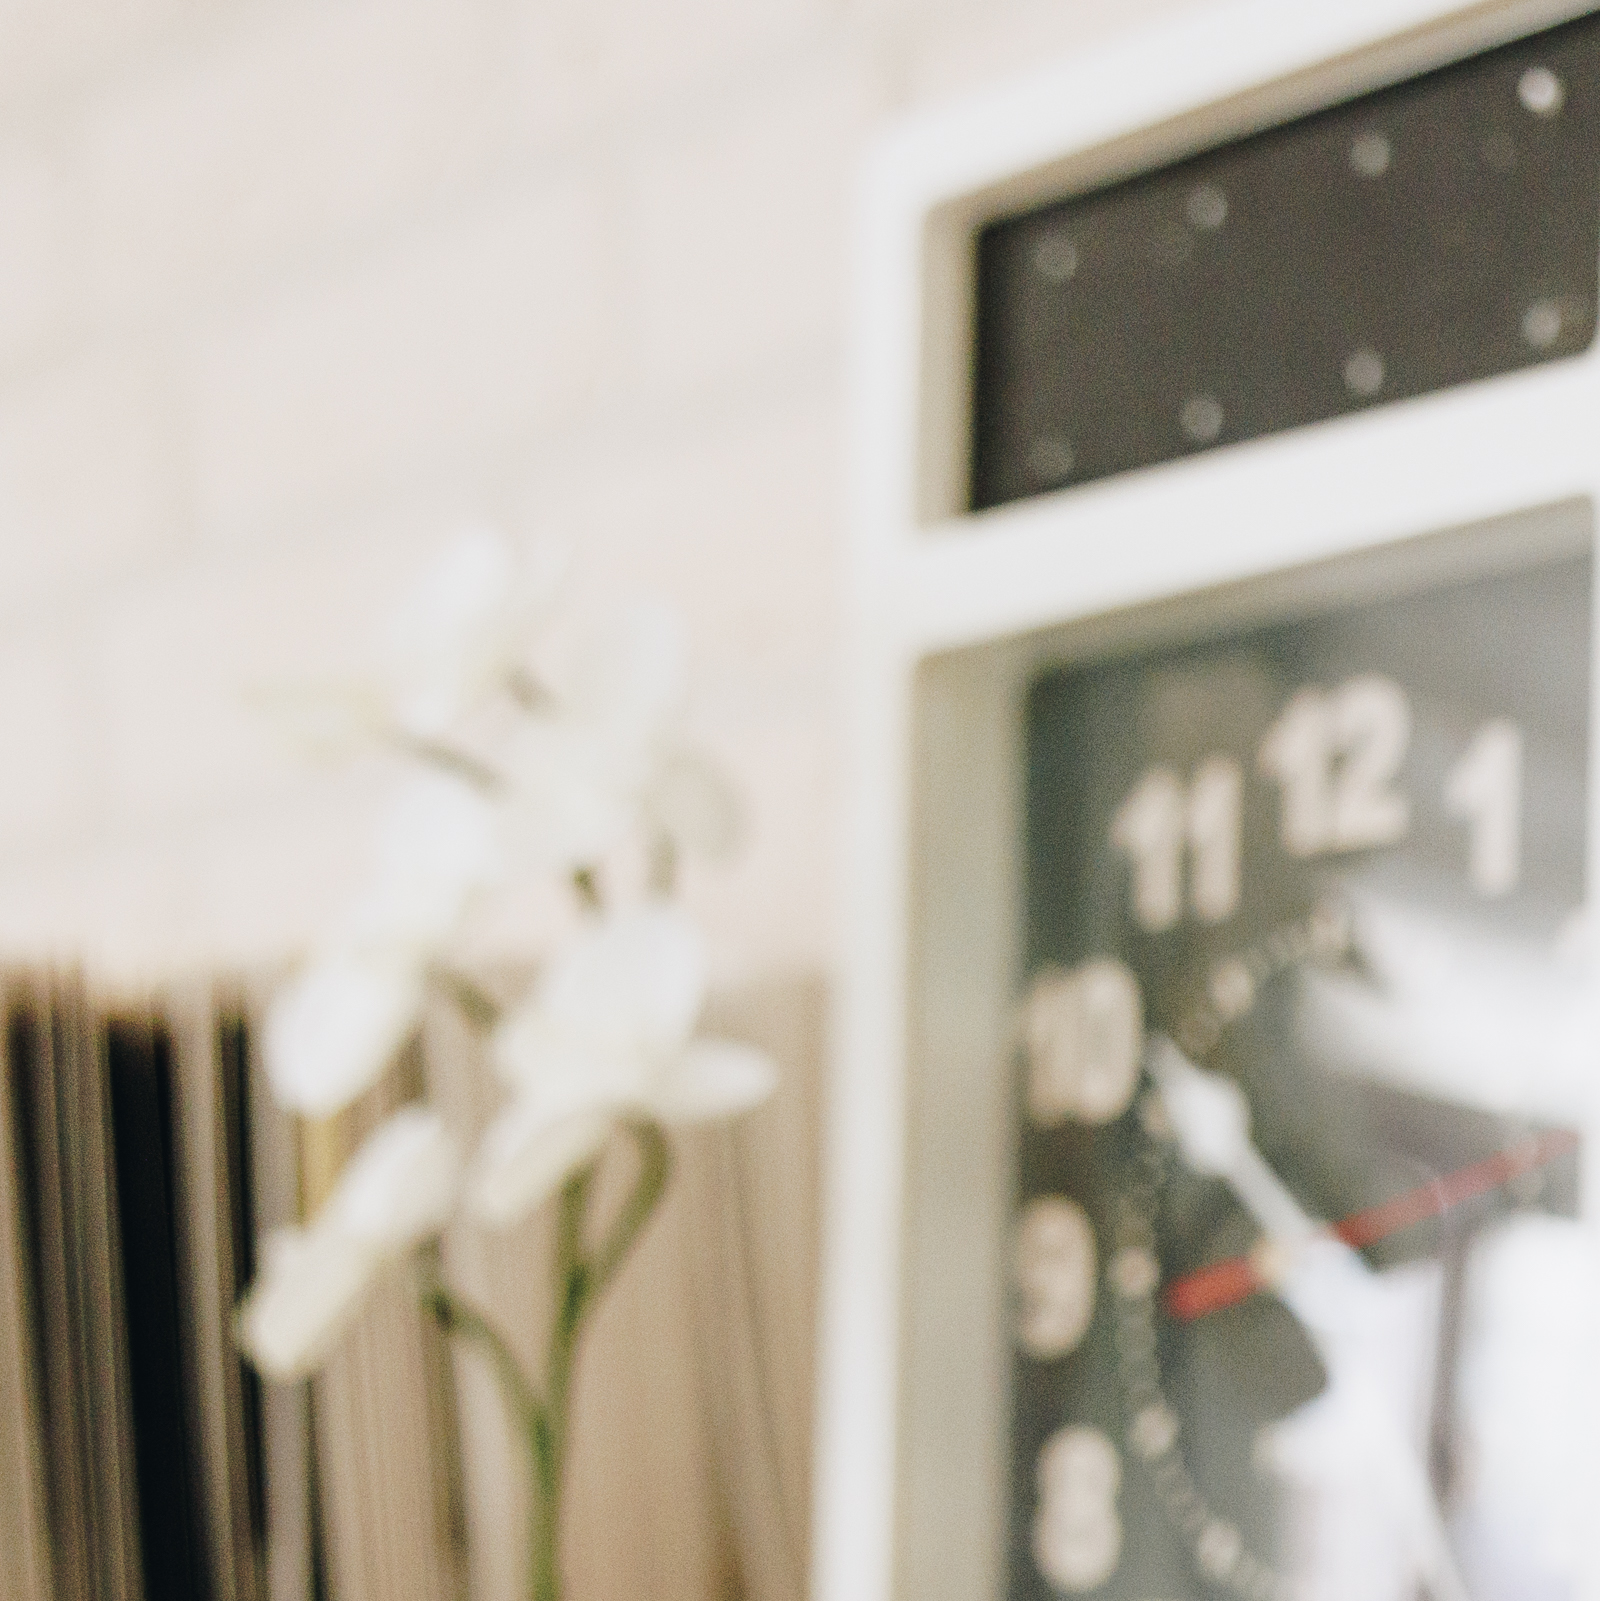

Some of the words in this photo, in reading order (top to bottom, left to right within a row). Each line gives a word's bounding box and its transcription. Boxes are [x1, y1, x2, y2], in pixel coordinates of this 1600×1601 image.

[1110, 755, 1244, 932] 11
[1260, 673, 1410, 856] 12
[1446, 716, 1523, 895] 1
[1034, 1424, 1122, 1593] 8
